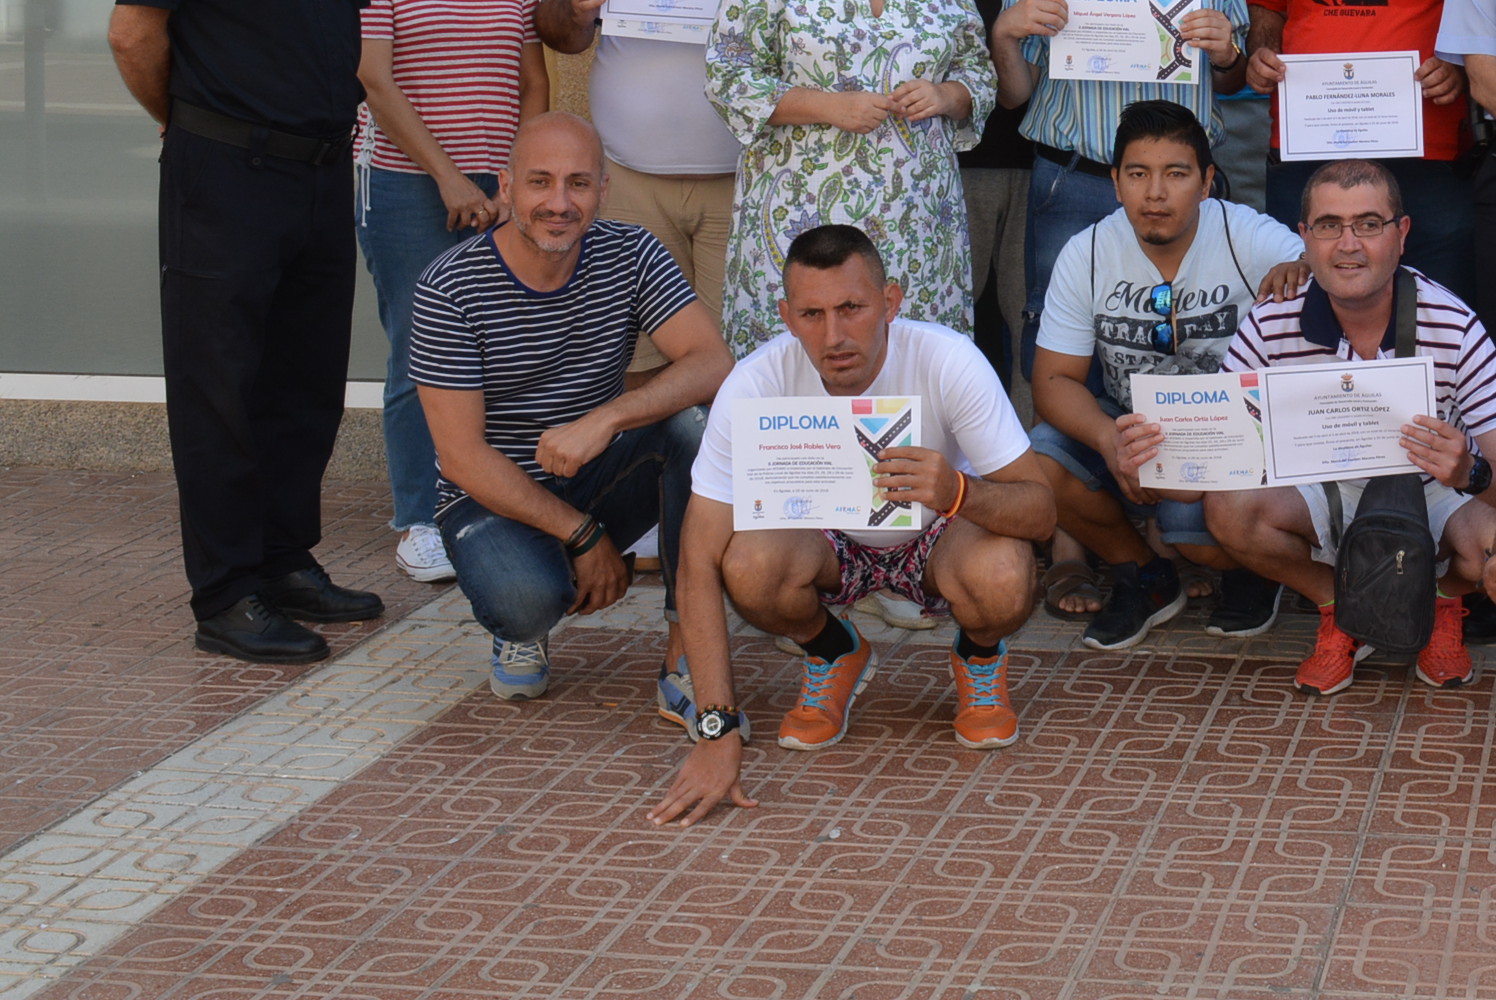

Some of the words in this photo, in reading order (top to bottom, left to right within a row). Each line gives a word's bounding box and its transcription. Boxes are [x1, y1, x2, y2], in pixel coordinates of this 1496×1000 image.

[1323, 9, 1338, 17] CHE
[1340, 9, 1377, 17] GUEVARA
[1156, 390, 1230, 406] DIPLOMA
[759, 415, 840, 431] DIPLOMA
